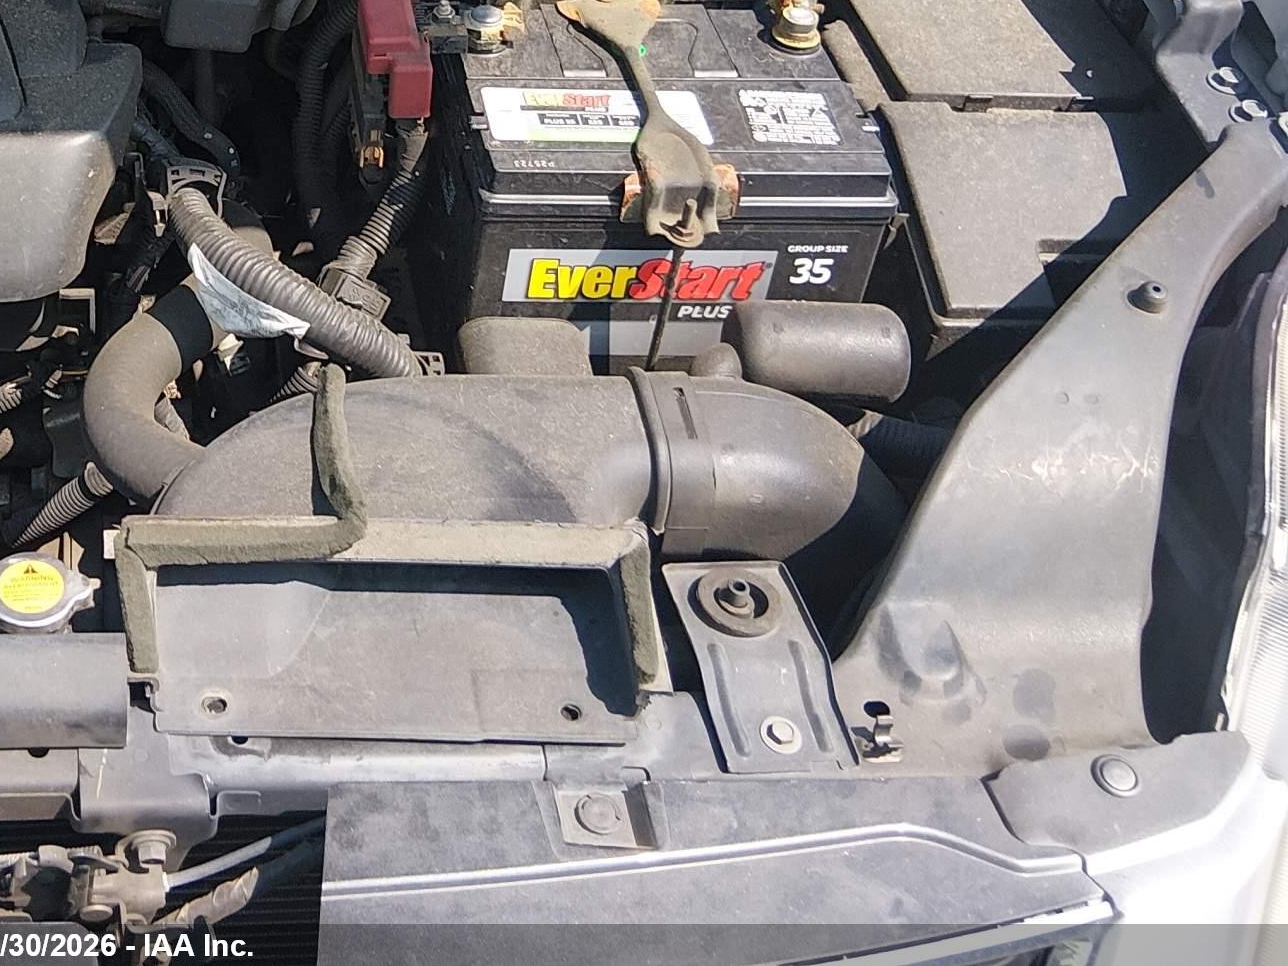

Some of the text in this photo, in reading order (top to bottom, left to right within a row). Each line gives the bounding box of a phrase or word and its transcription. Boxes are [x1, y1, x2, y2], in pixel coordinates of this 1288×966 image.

[787, 244, 849, 254] GROUP SIZE
[526, 258, 765, 302] EverStart
[789, 257, 835, 285] 35
[677, 305, 733, 319] PLUS
